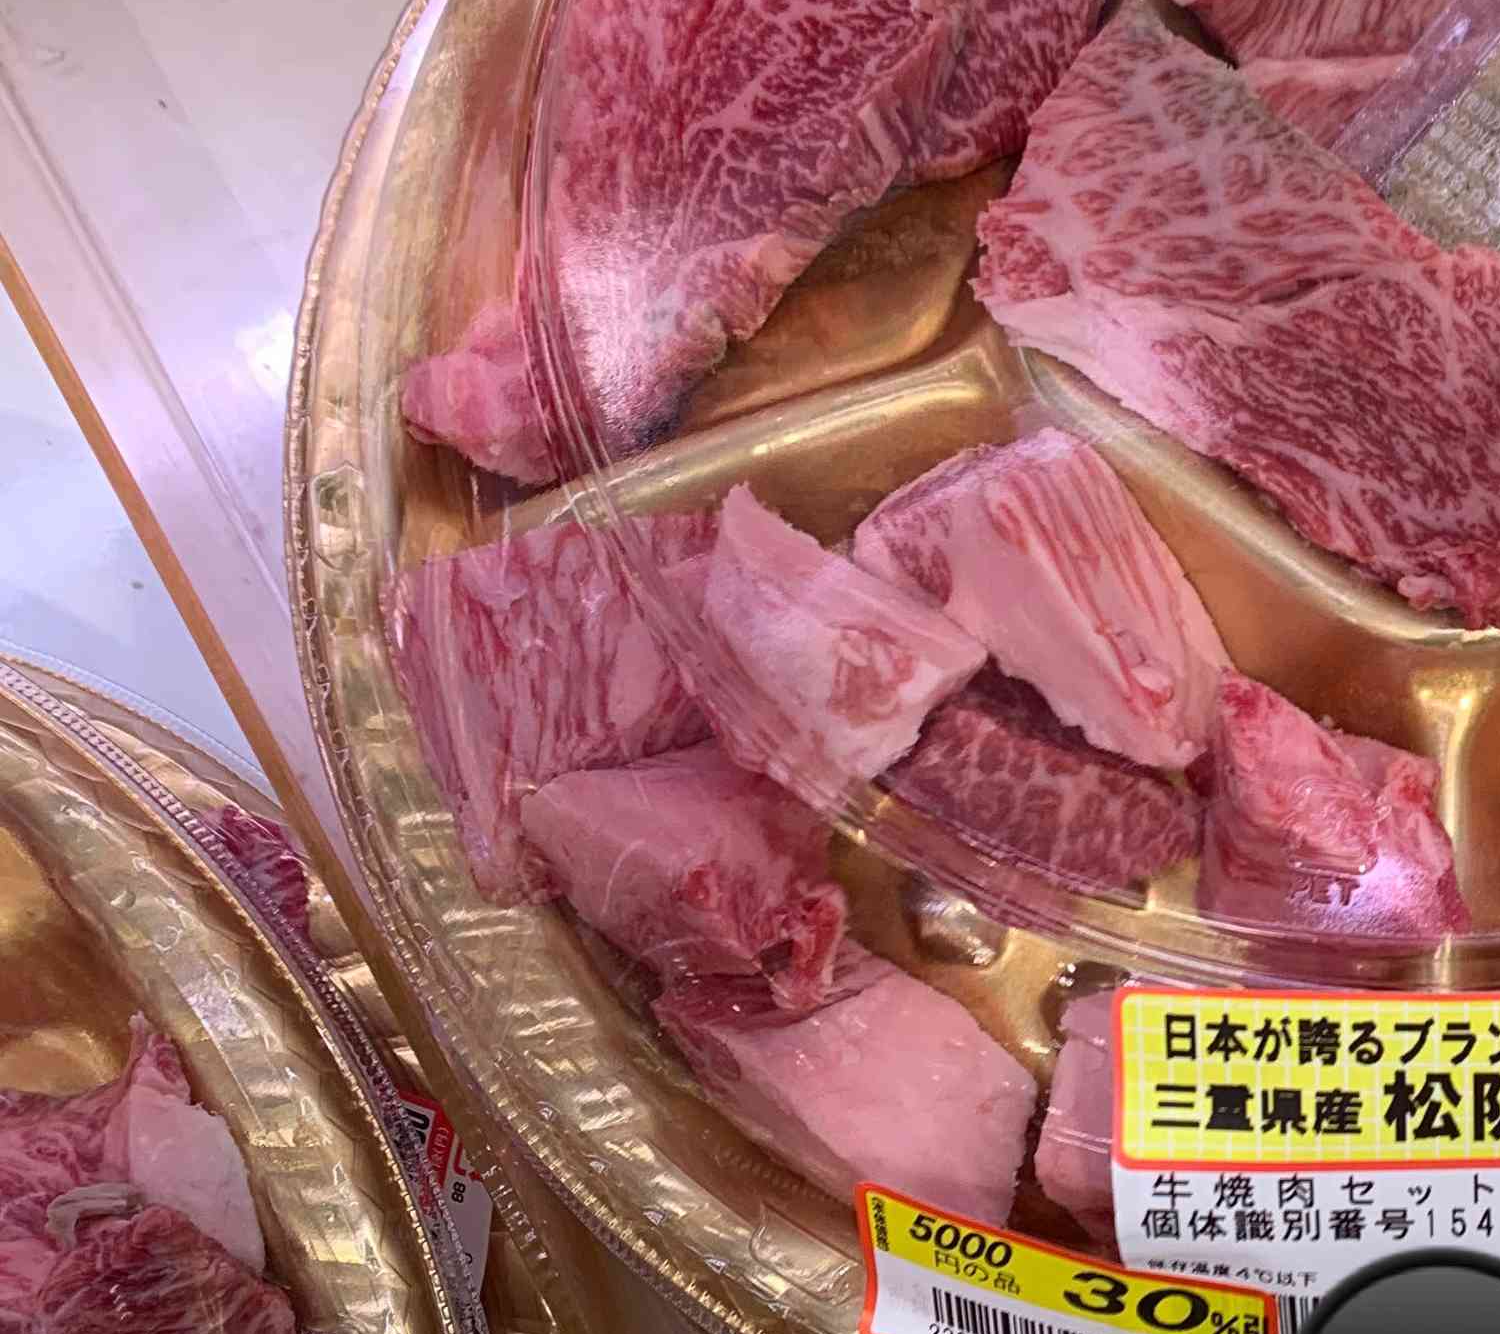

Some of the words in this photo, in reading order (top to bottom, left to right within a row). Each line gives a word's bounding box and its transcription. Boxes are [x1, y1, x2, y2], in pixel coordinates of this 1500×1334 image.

[1151, 1082, 1364, 1135] 三重県産
[451, 1181, 466, 1204] 88
[908, 1213, 1013, 1268] 5000
[934, 1249, 1022, 1296] 円の品
